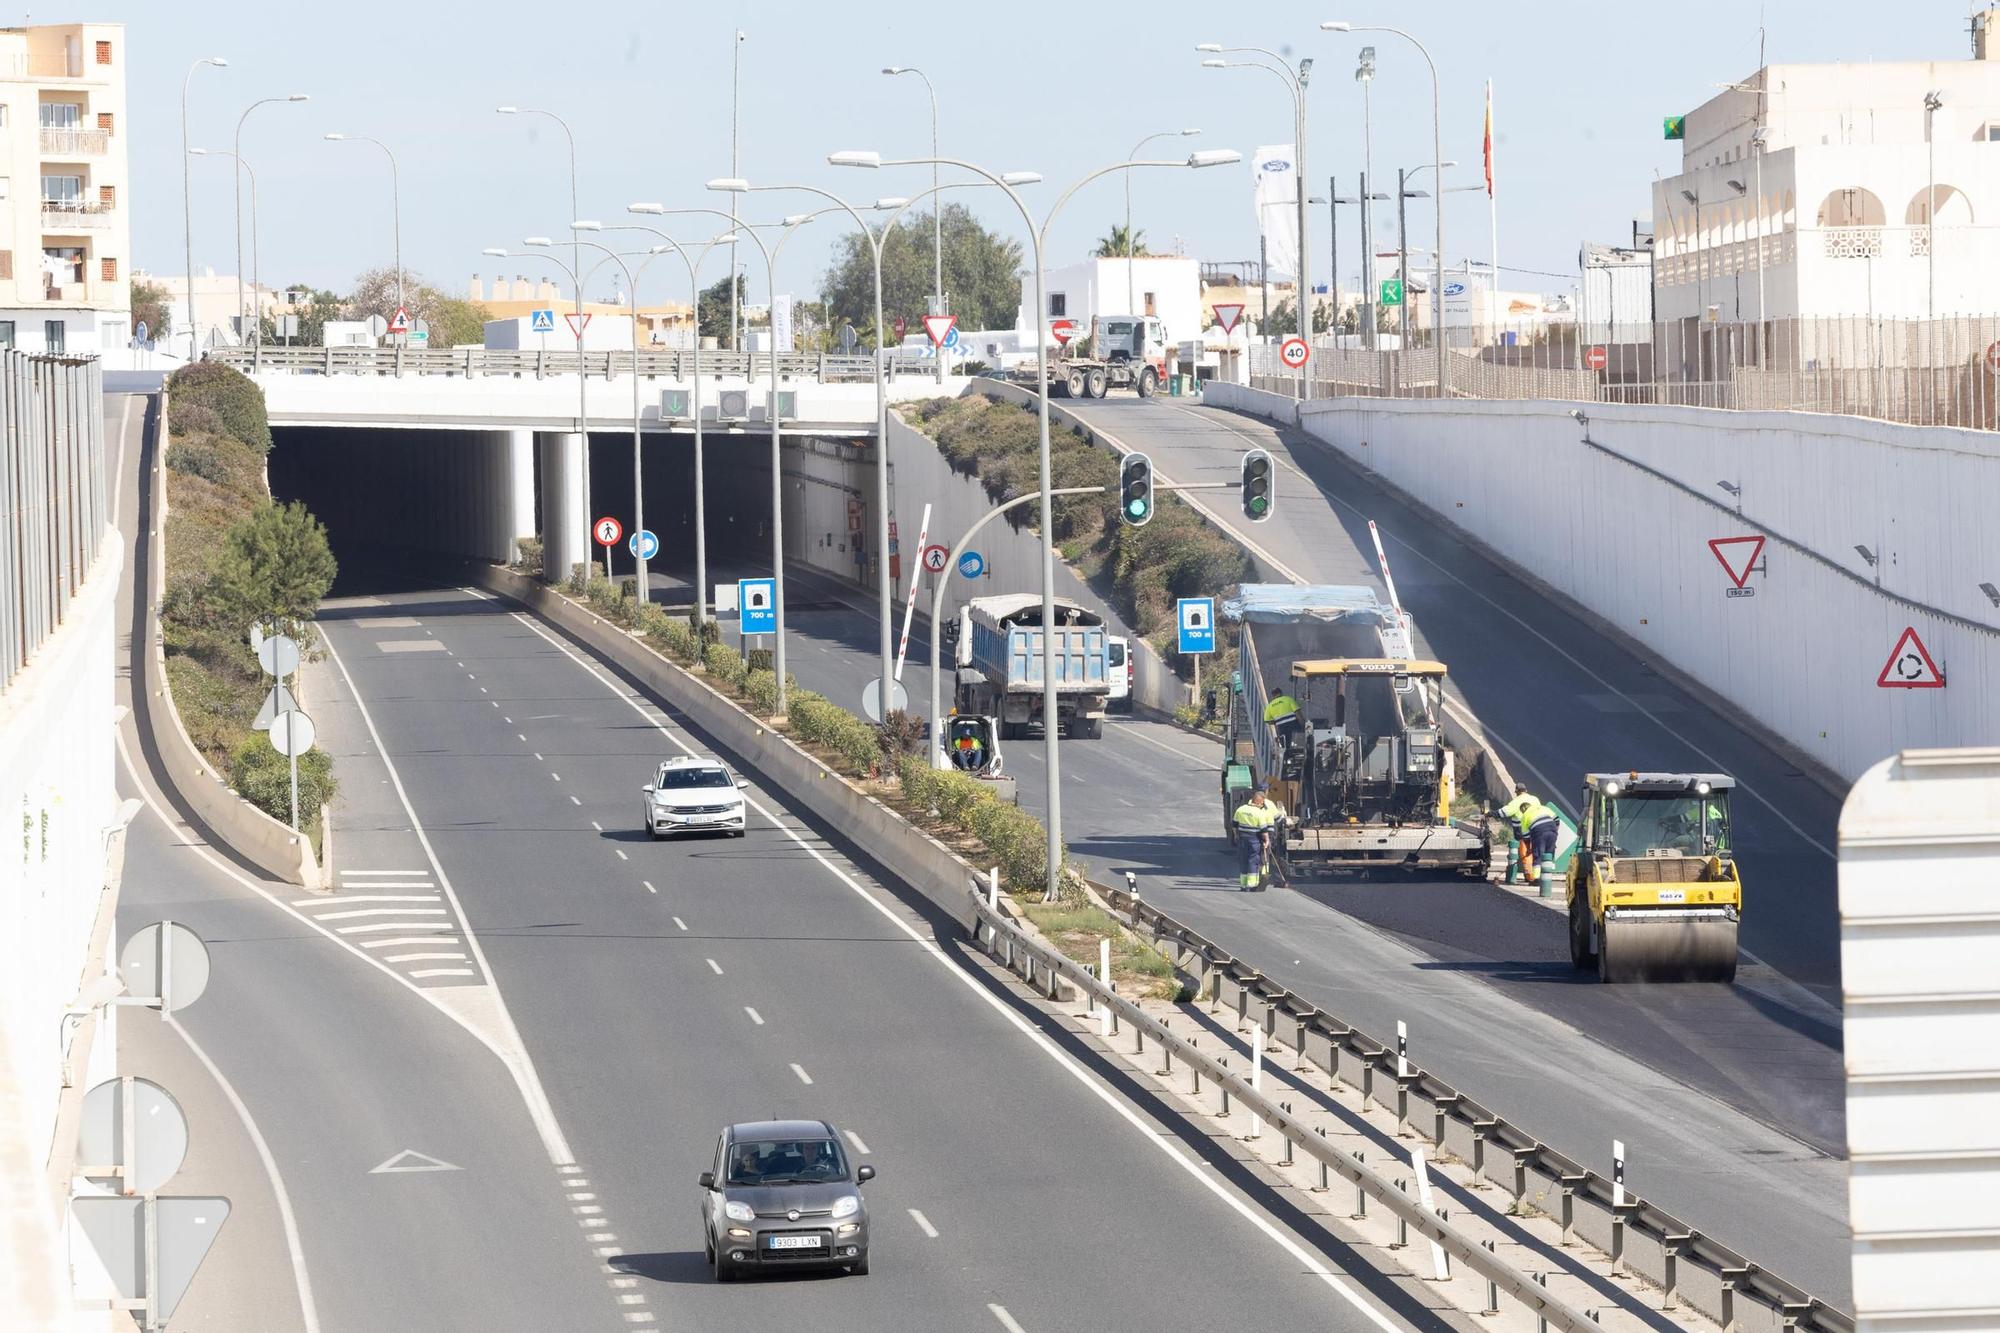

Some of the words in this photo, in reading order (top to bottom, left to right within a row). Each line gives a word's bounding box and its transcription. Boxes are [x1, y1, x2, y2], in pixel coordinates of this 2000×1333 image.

[1287, 347, 1304, 358] 40
[777, 1238, 797, 1247] 9303
[801, 1236, 818, 1247] LXN
